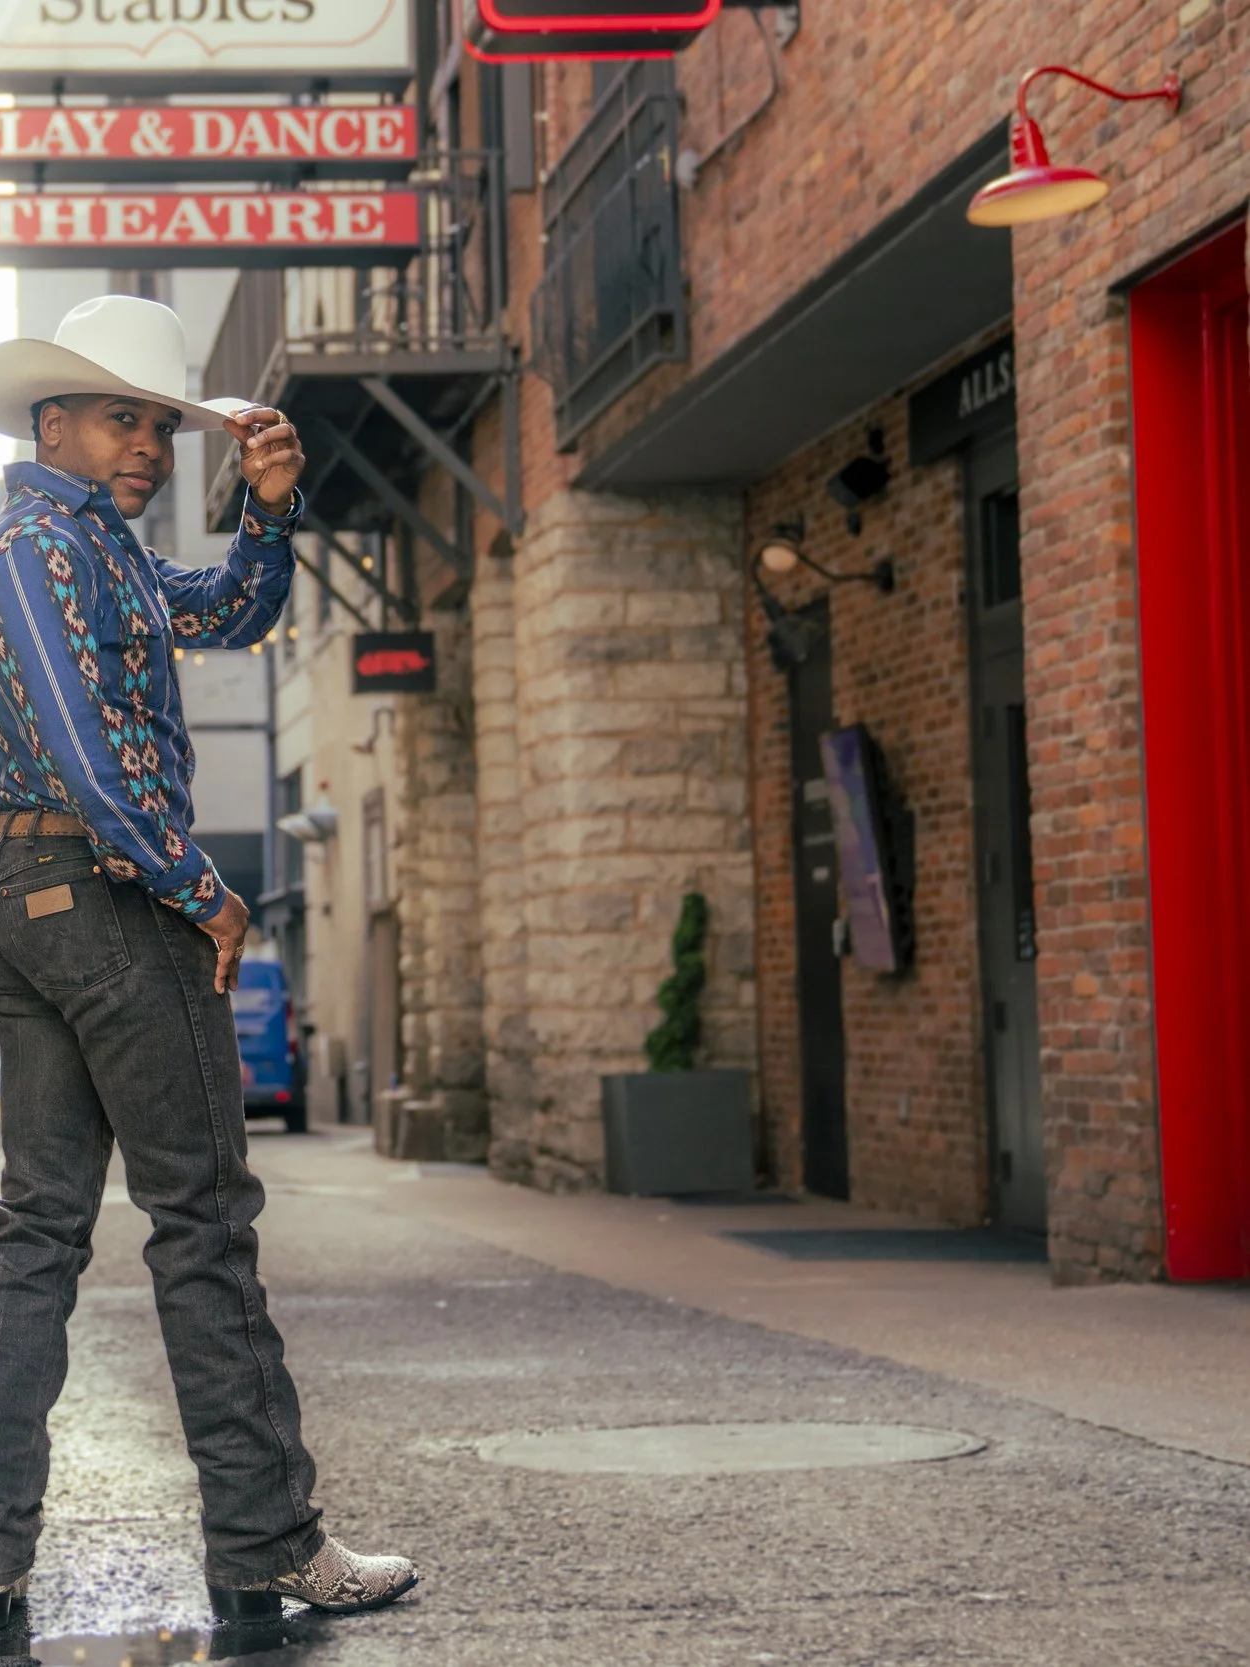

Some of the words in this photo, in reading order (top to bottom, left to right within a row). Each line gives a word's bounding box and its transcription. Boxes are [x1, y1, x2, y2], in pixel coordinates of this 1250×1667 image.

[131, 110, 174, 157] &
[190, 110, 405, 157] DANCE
[958, 351, 1013, 419] ALLS
